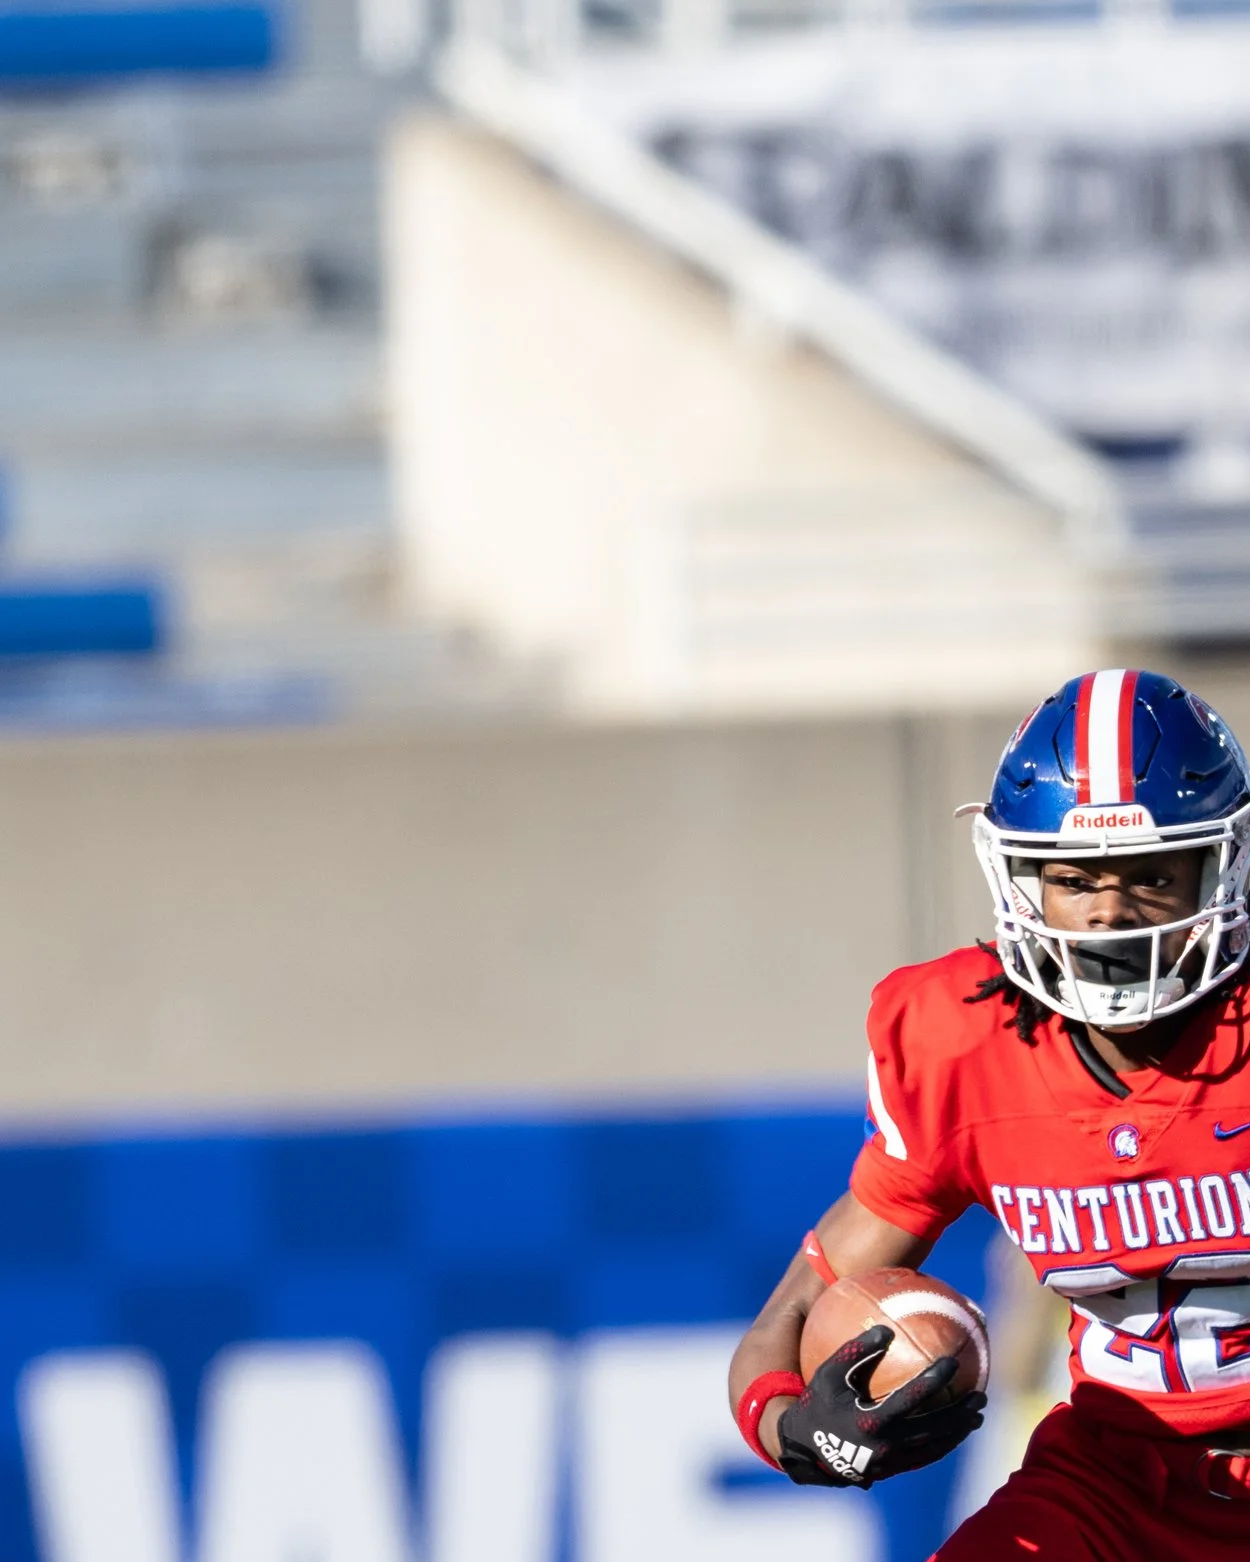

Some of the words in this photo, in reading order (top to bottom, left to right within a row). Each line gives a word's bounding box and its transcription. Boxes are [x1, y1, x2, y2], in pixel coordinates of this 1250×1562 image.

[1073, 812, 1143, 829] Riddell
[1100, 990, 1136, 1000] Riddell
[813, 1430, 865, 1482] adidas
